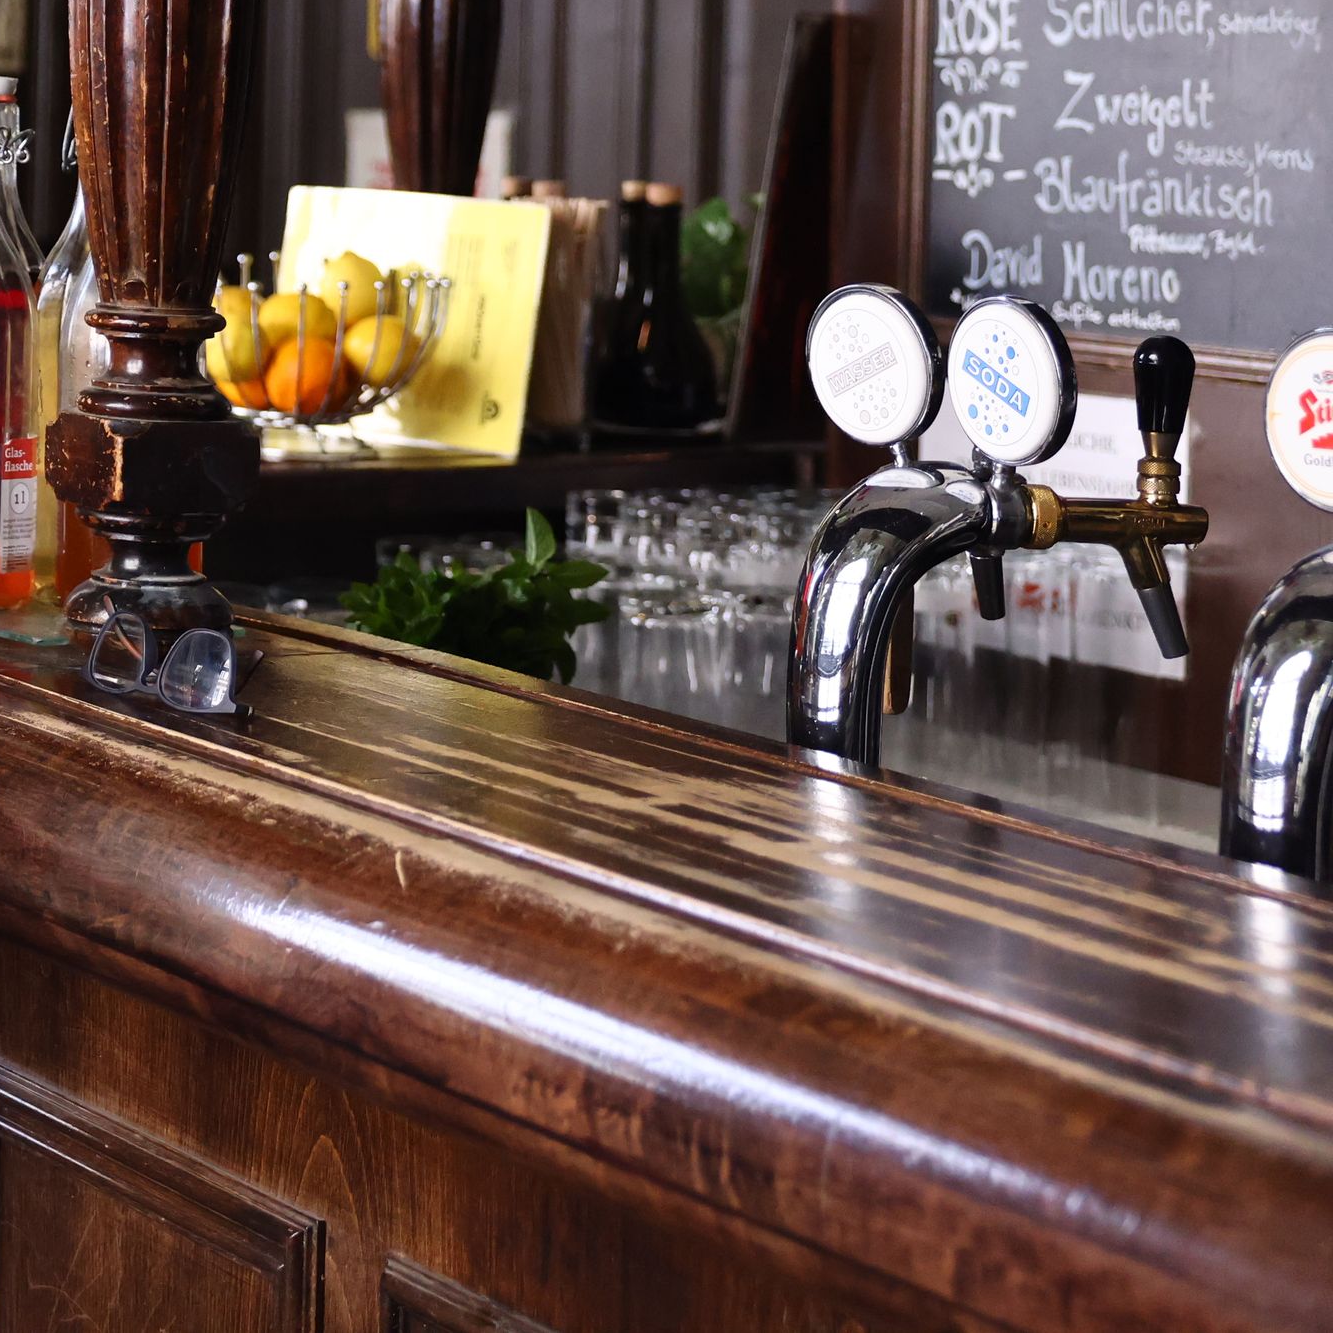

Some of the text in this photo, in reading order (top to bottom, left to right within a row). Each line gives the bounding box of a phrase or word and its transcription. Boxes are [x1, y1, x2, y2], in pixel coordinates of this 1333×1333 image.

[934, 100, 1017, 164] ROT
[1055, 69, 1215, 156] Zweigelt
[1033, 149, 1274, 233] Blaufränkisch
[961, 229, 1181, 304] David Moreno
[829, 346, 898, 394] WASSER
[966, 355, 1025, 412] SODA
[4, 446, 26, 459] Glas-
[4, 459, 33, 473] flasche
